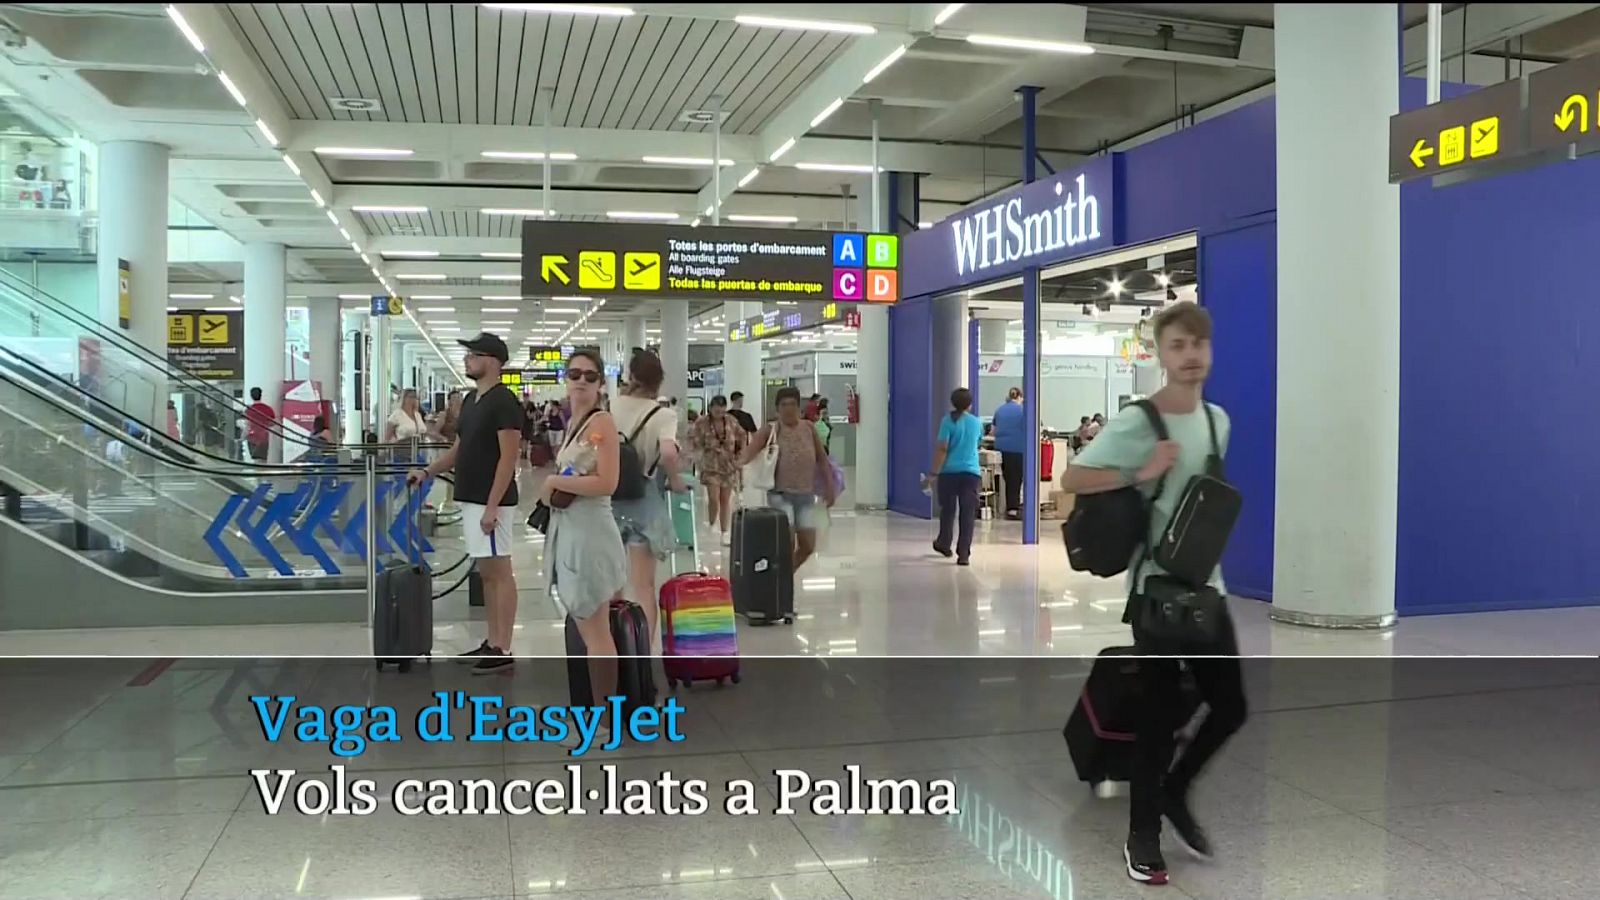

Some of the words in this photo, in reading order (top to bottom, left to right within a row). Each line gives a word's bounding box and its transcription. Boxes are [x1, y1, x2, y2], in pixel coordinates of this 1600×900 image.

[952, 173, 1100, 276] WHSmith
[669, 240, 697, 251] Totes
[700, 240, 714, 251] les
[716, 243, 748, 254] portes
[750, 242, 826, 256] d'embarcament
[840, 239, 856, 261] A
[875, 241, 889, 262] B
[669, 252, 679, 261] All
[681, 253, 715, 264] boarding
[717, 255, 740, 265] gates
[669, 265, 683, 275] Alle
[685, 265, 726, 277] Flugsteige
[669, 277, 699, 289] Todas
[702, 278, 716, 289] las
[719, 280, 756, 291] puertas
[758, 280, 771, 291] de
[773, 280, 823, 294] embarque
[840, 273, 856, 296] C
[874, 275, 889, 296] D
